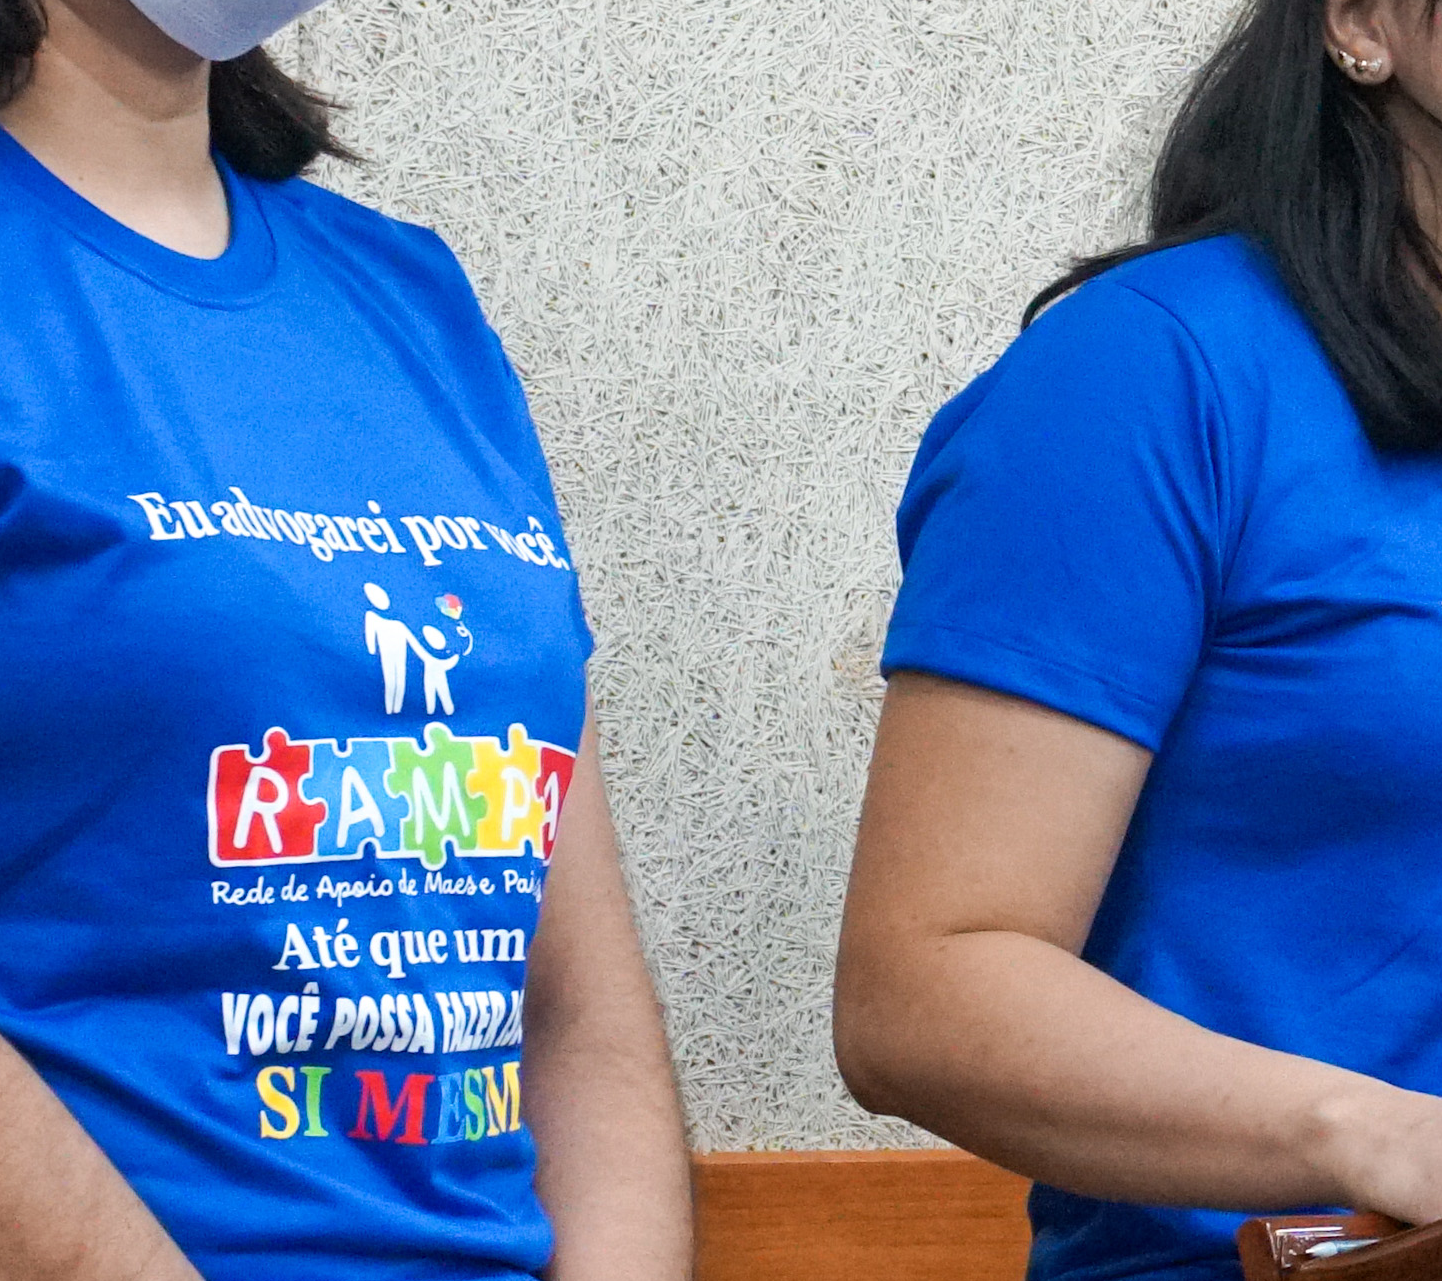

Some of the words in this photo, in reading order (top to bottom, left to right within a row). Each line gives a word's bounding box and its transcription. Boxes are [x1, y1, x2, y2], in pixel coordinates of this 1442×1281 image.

[127, 492, 218, 541] Eu
[211, 486, 406, 563] advogarei
[400, 515, 488, 566] por
[211, 876, 275, 906] Rede
[281, 874, 309, 902] de
[316, 874, 394, 907] Apoio
[398, 868, 418, 896] de
[271, 918, 361, 970] Até
[369, 928, 448, 979] que
[453, 928, 526, 964] um
[221, 982, 320, 1055] VOCÊ
[324, 993, 435, 1054] POSSA
[435, 990, 506, 1054] FAZER
[255, 1065, 332, 1140] SI
